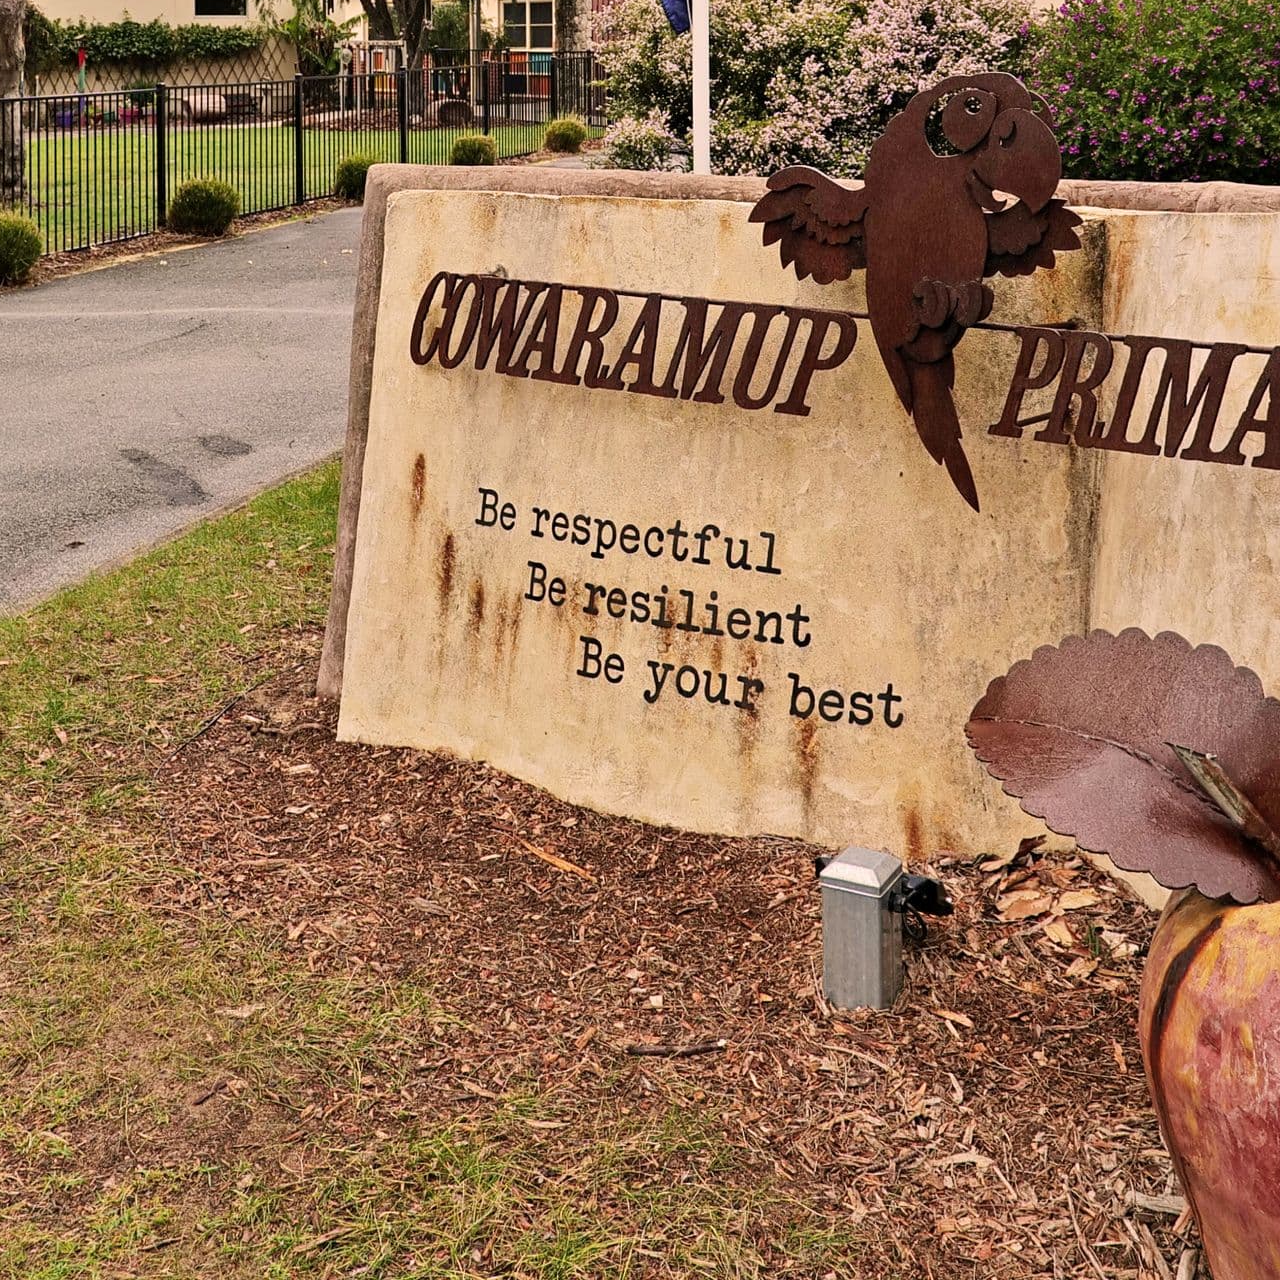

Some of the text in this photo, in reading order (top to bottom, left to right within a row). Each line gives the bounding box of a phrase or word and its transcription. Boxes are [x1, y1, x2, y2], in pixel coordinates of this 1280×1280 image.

[410, 271, 858, 416] COWARAMUP
[475, 488, 782, 575] Be respectful
[525, 561, 812, 647] Be resilient
[576, 636, 904, 728] Be your best
